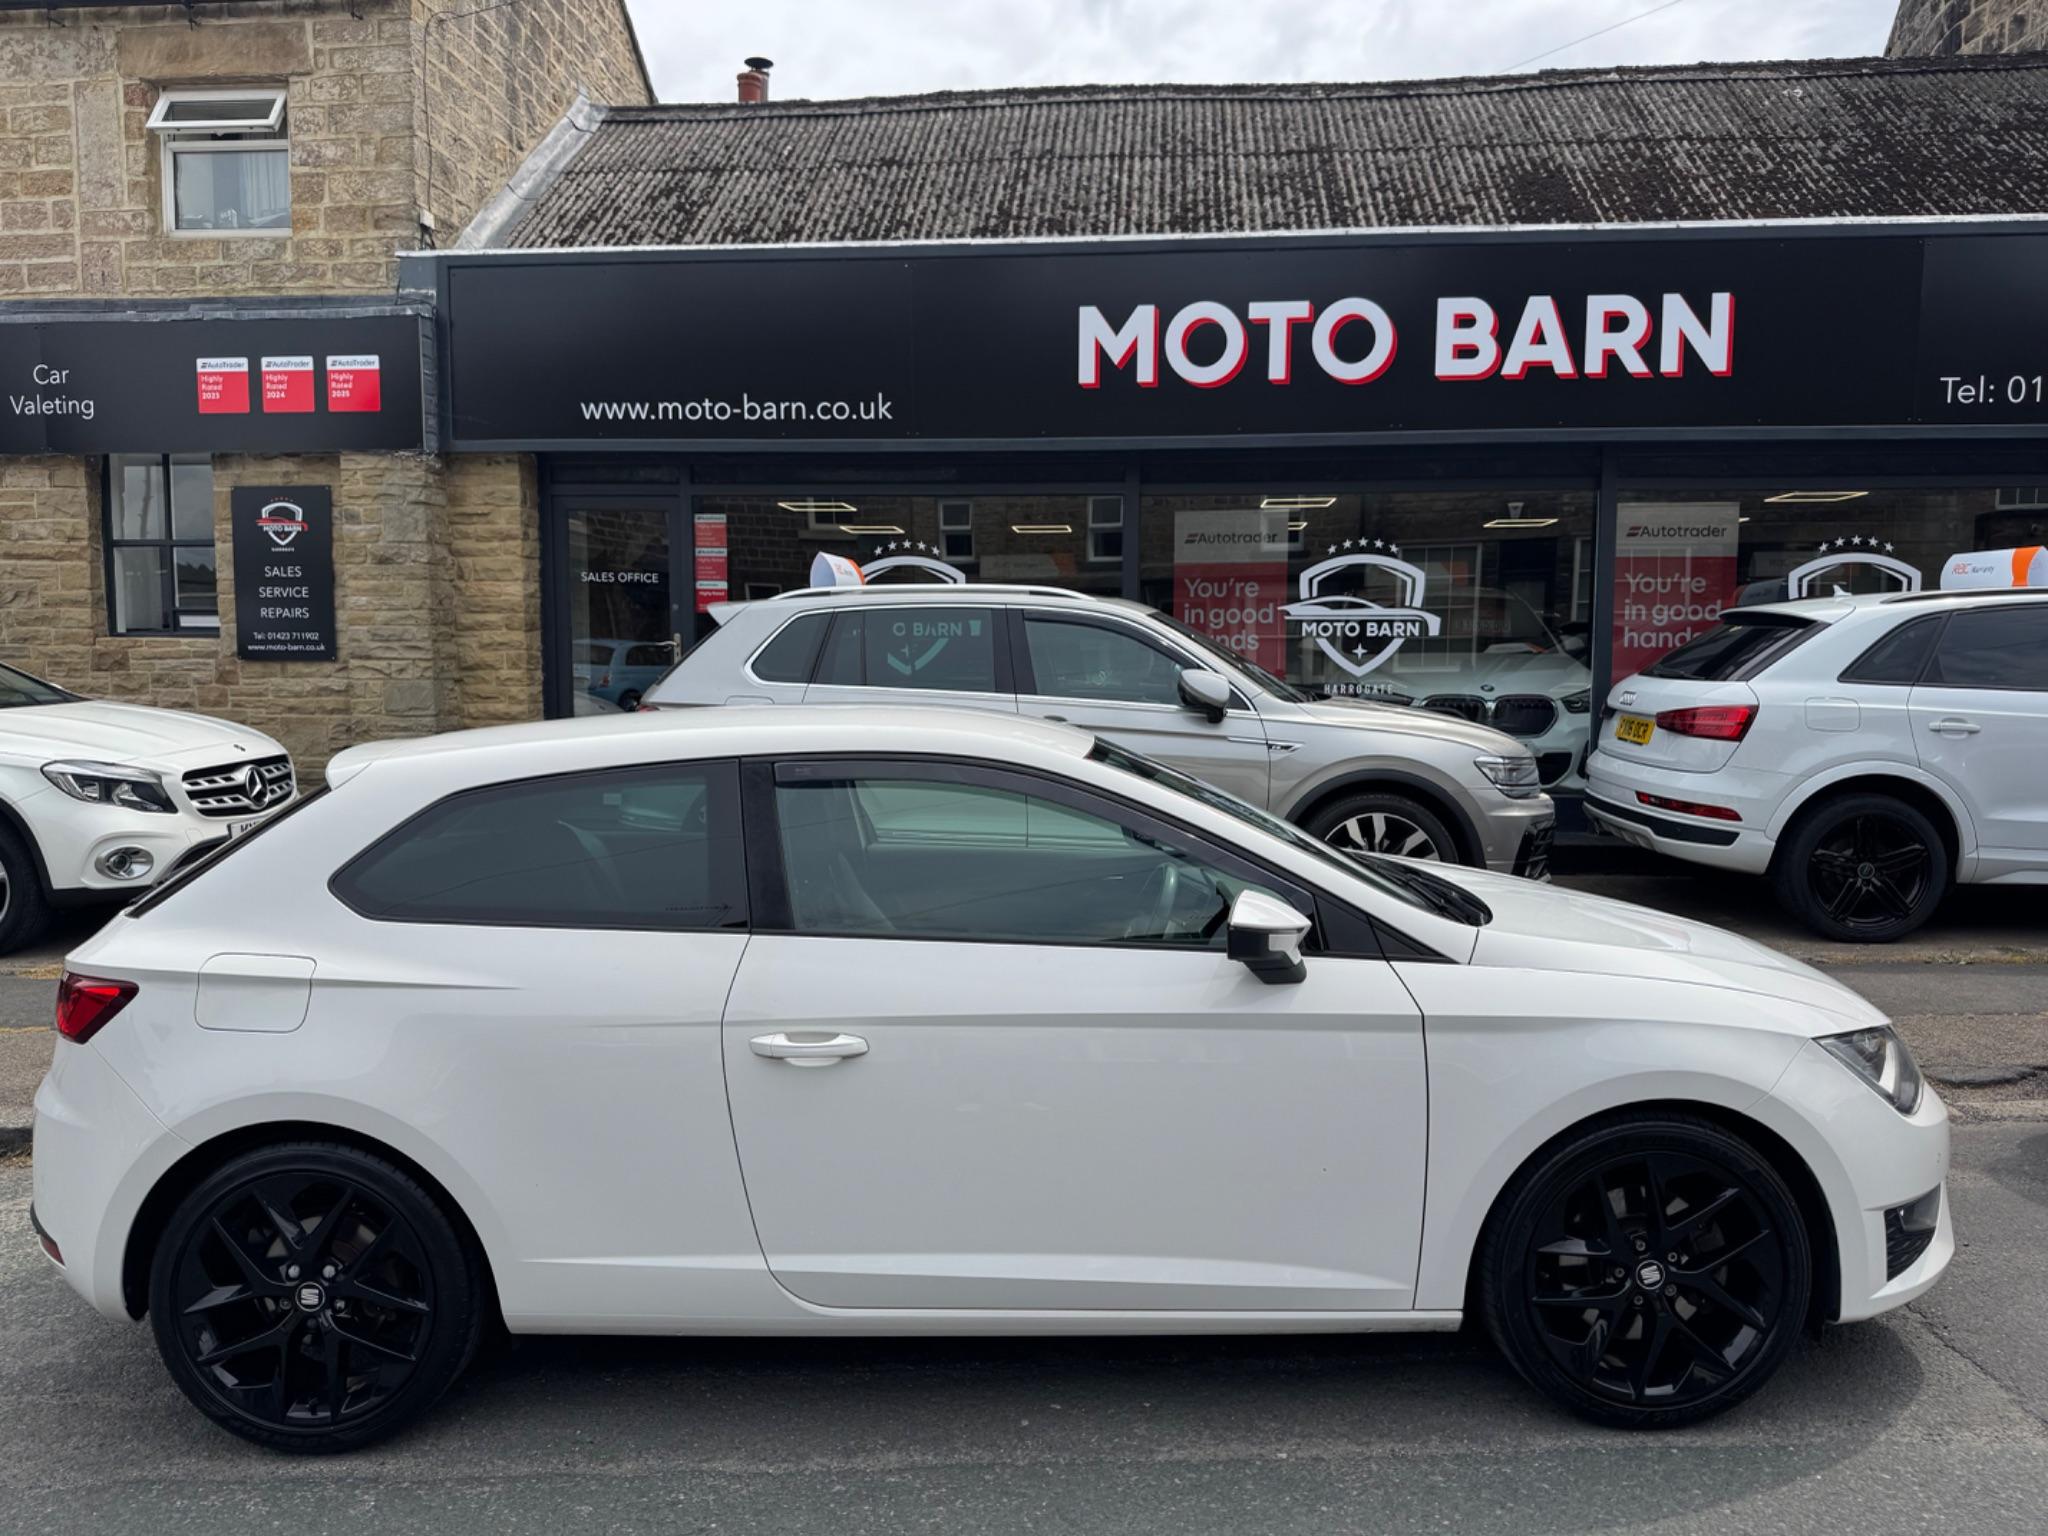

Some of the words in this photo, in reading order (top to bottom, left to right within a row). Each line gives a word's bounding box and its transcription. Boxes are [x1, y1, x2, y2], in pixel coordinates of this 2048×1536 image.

[1078, 296, 1398, 389] MOTO
[1434, 292, 1735, 381] BARN
[33, 363, 70, 385] Car
[1939, 375, 1995, 404] Tel:
[2007, 375, 2042, 404] 01
[9, 393, 94, 420] Valeting
[579, 392, 894, 420] www.moto-barn.co.uk
[1197, 532, 1278, 545] Autotrader
[1640, 525, 1727, 538] Autotrader
[264, 566, 302, 577] SALES
[580, 571, 615, 583] SALES
[617, 572, 660, 583] OFFICE
[259, 587, 309, 598] SERVICE
[260, 607, 309, 618] REPAIRS
[1184, 603, 1205, 624] in
[1208, 602, 1275, 629] good
[1624, 599, 1646, 621] in
[1651, 599, 1722, 626] good
[912, 622, 963, 637] BARN
[1301, 621, 1360, 637] MOTO
[1366, 621, 1420, 637] BARN
[1211, 629, 1260, 651] nds
[1623, 626, 1702, 649] hand
[247, 643, 326, 651] www.moto-barn.co.uk
[1324, 684, 1393, 694] HARROGATE
